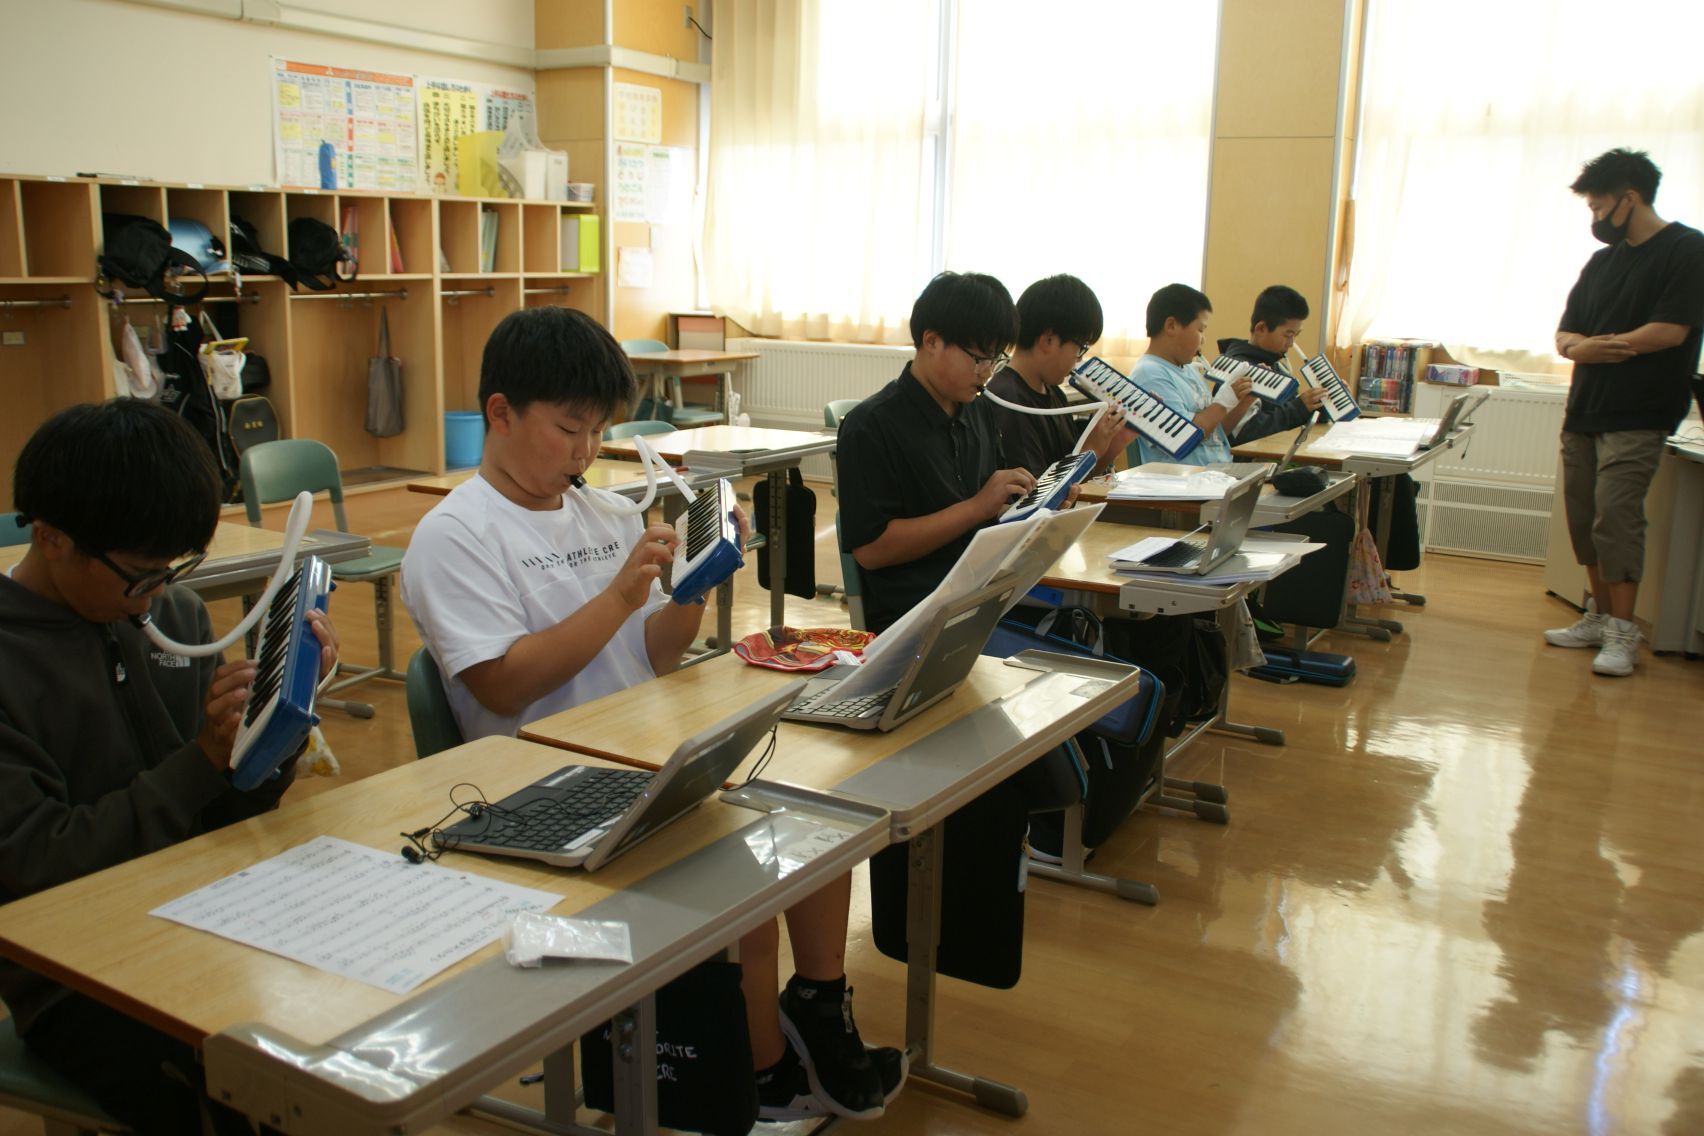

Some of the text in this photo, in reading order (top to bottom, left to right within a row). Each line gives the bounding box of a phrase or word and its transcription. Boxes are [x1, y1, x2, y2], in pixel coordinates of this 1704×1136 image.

[566, 547, 599, 561] ATHLEE
[151, 652, 175, 660] NORTH
[656, 1042, 698, 1059] ORITE
